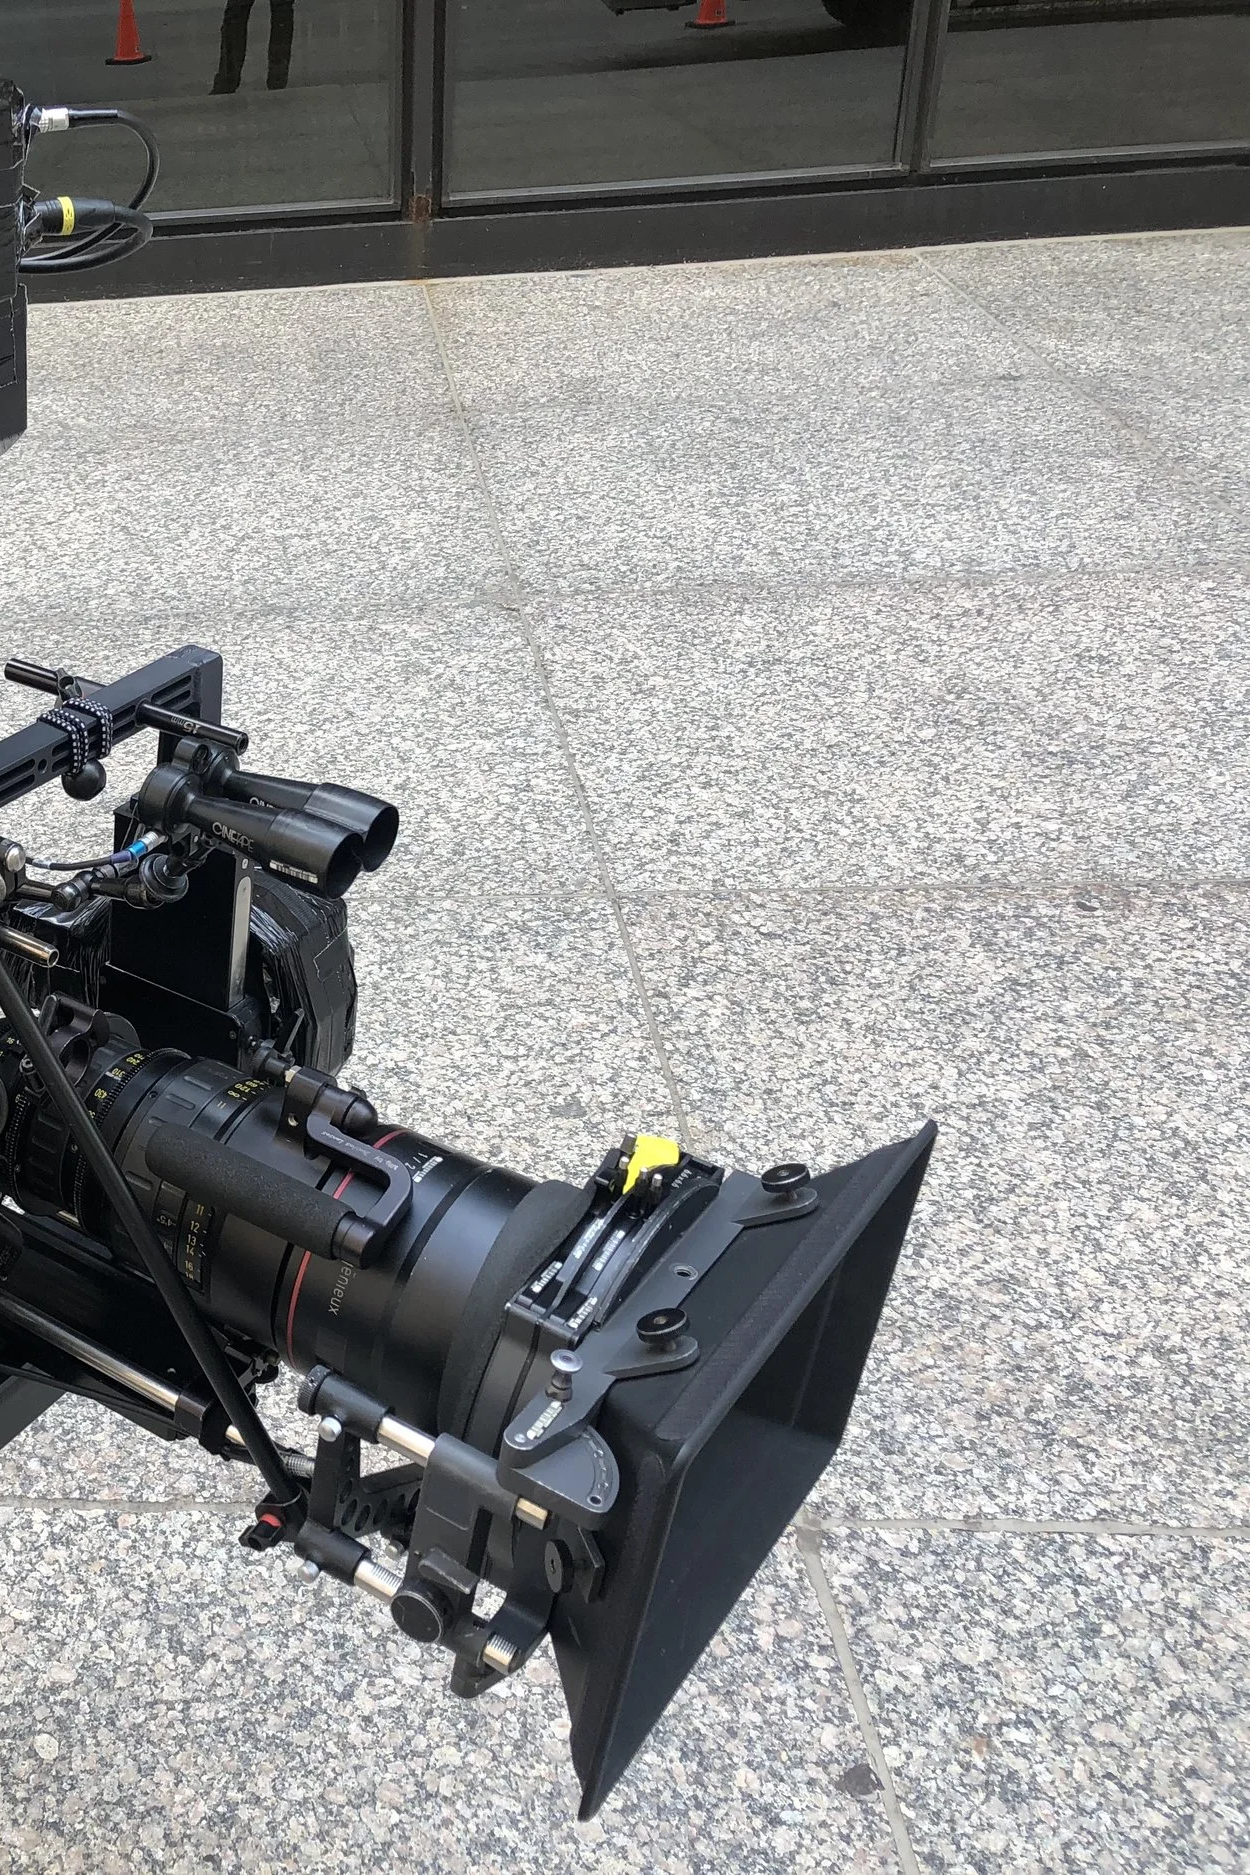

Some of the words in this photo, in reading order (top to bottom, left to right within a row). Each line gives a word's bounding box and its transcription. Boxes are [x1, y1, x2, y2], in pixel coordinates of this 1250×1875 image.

[170, 716, 200, 733] 15mm
[212, 822, 255, 853] CINETAPE
[190, 1220, 200, 1233] 12
[188, 1234, 197, 1246] 13
[186, 1244, 195, 1256] 14
[184, 1260, 193, 1271] 16
